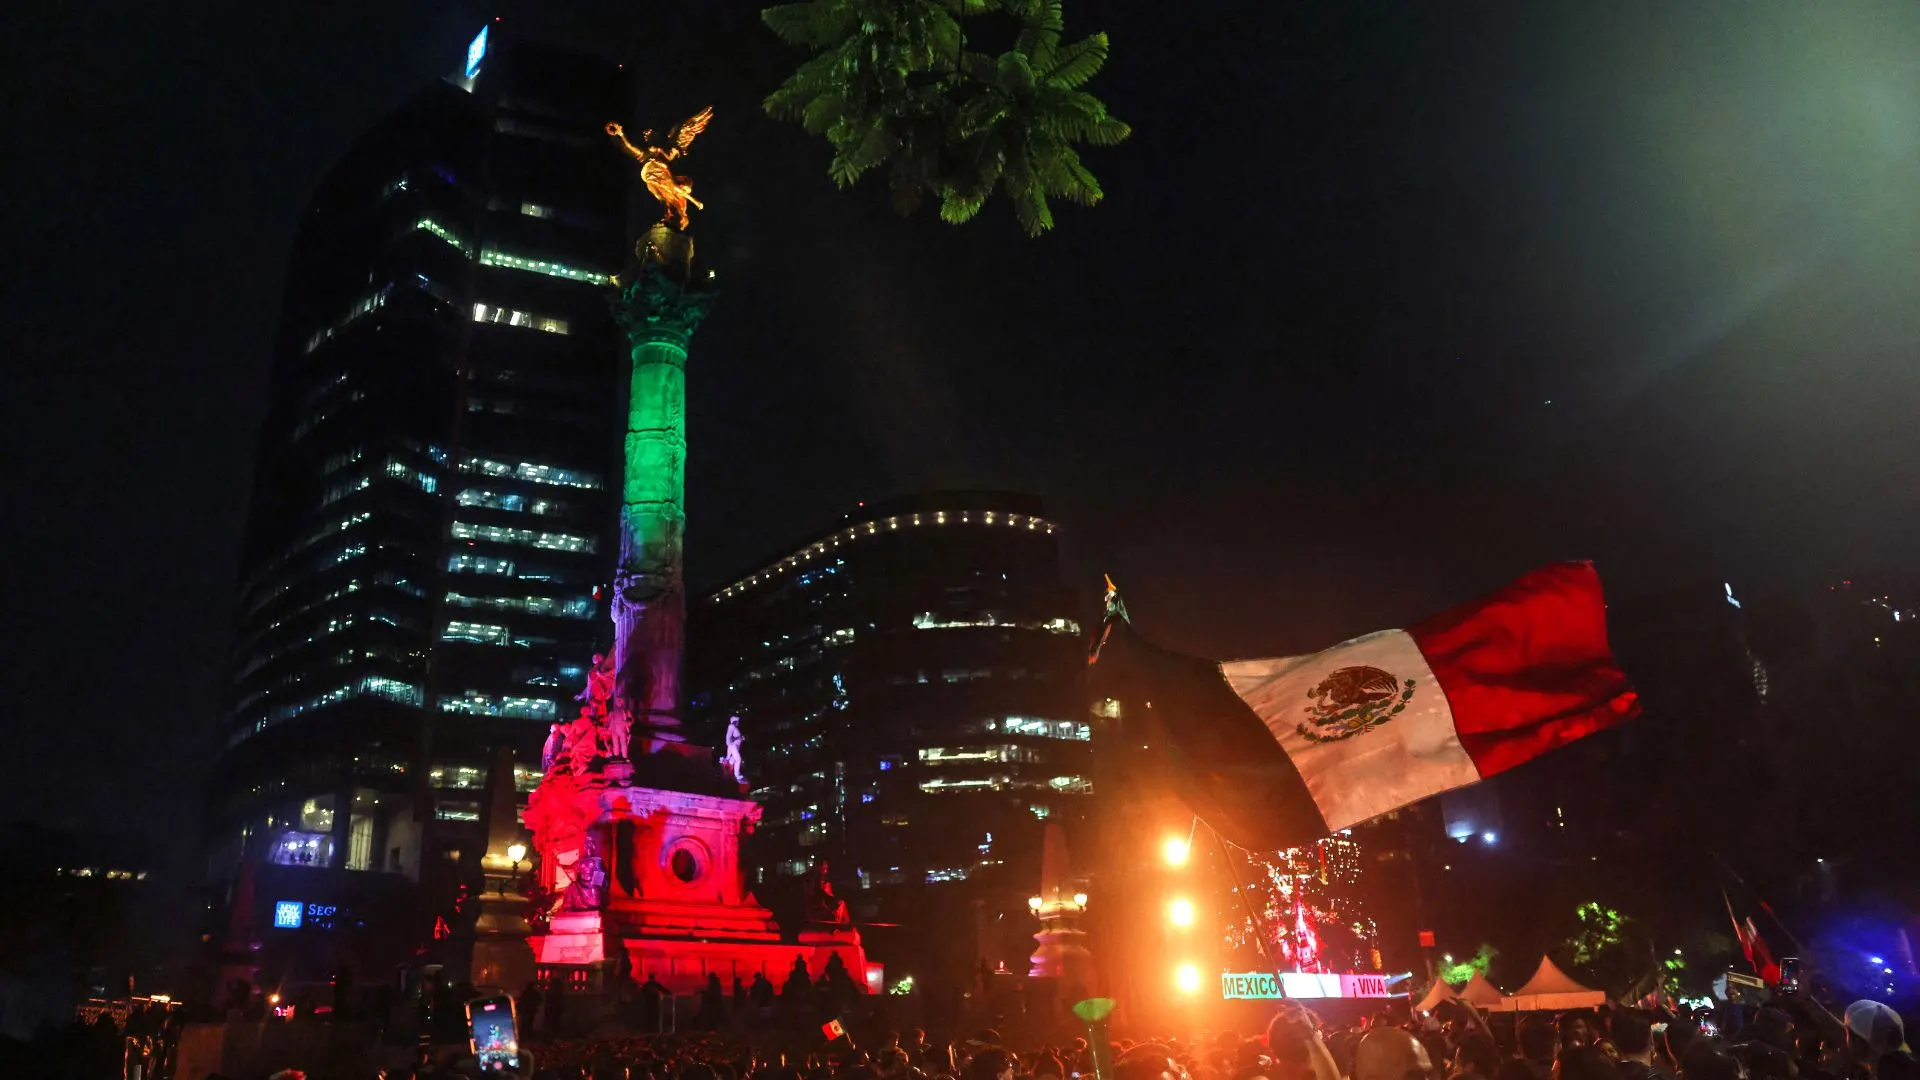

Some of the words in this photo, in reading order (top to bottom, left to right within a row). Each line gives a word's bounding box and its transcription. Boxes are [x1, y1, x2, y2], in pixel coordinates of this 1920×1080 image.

[280, 903, 299, 912] NEW
[277, 909, 300, 919] YORK
[278, 917, 297, 926] LIFE
